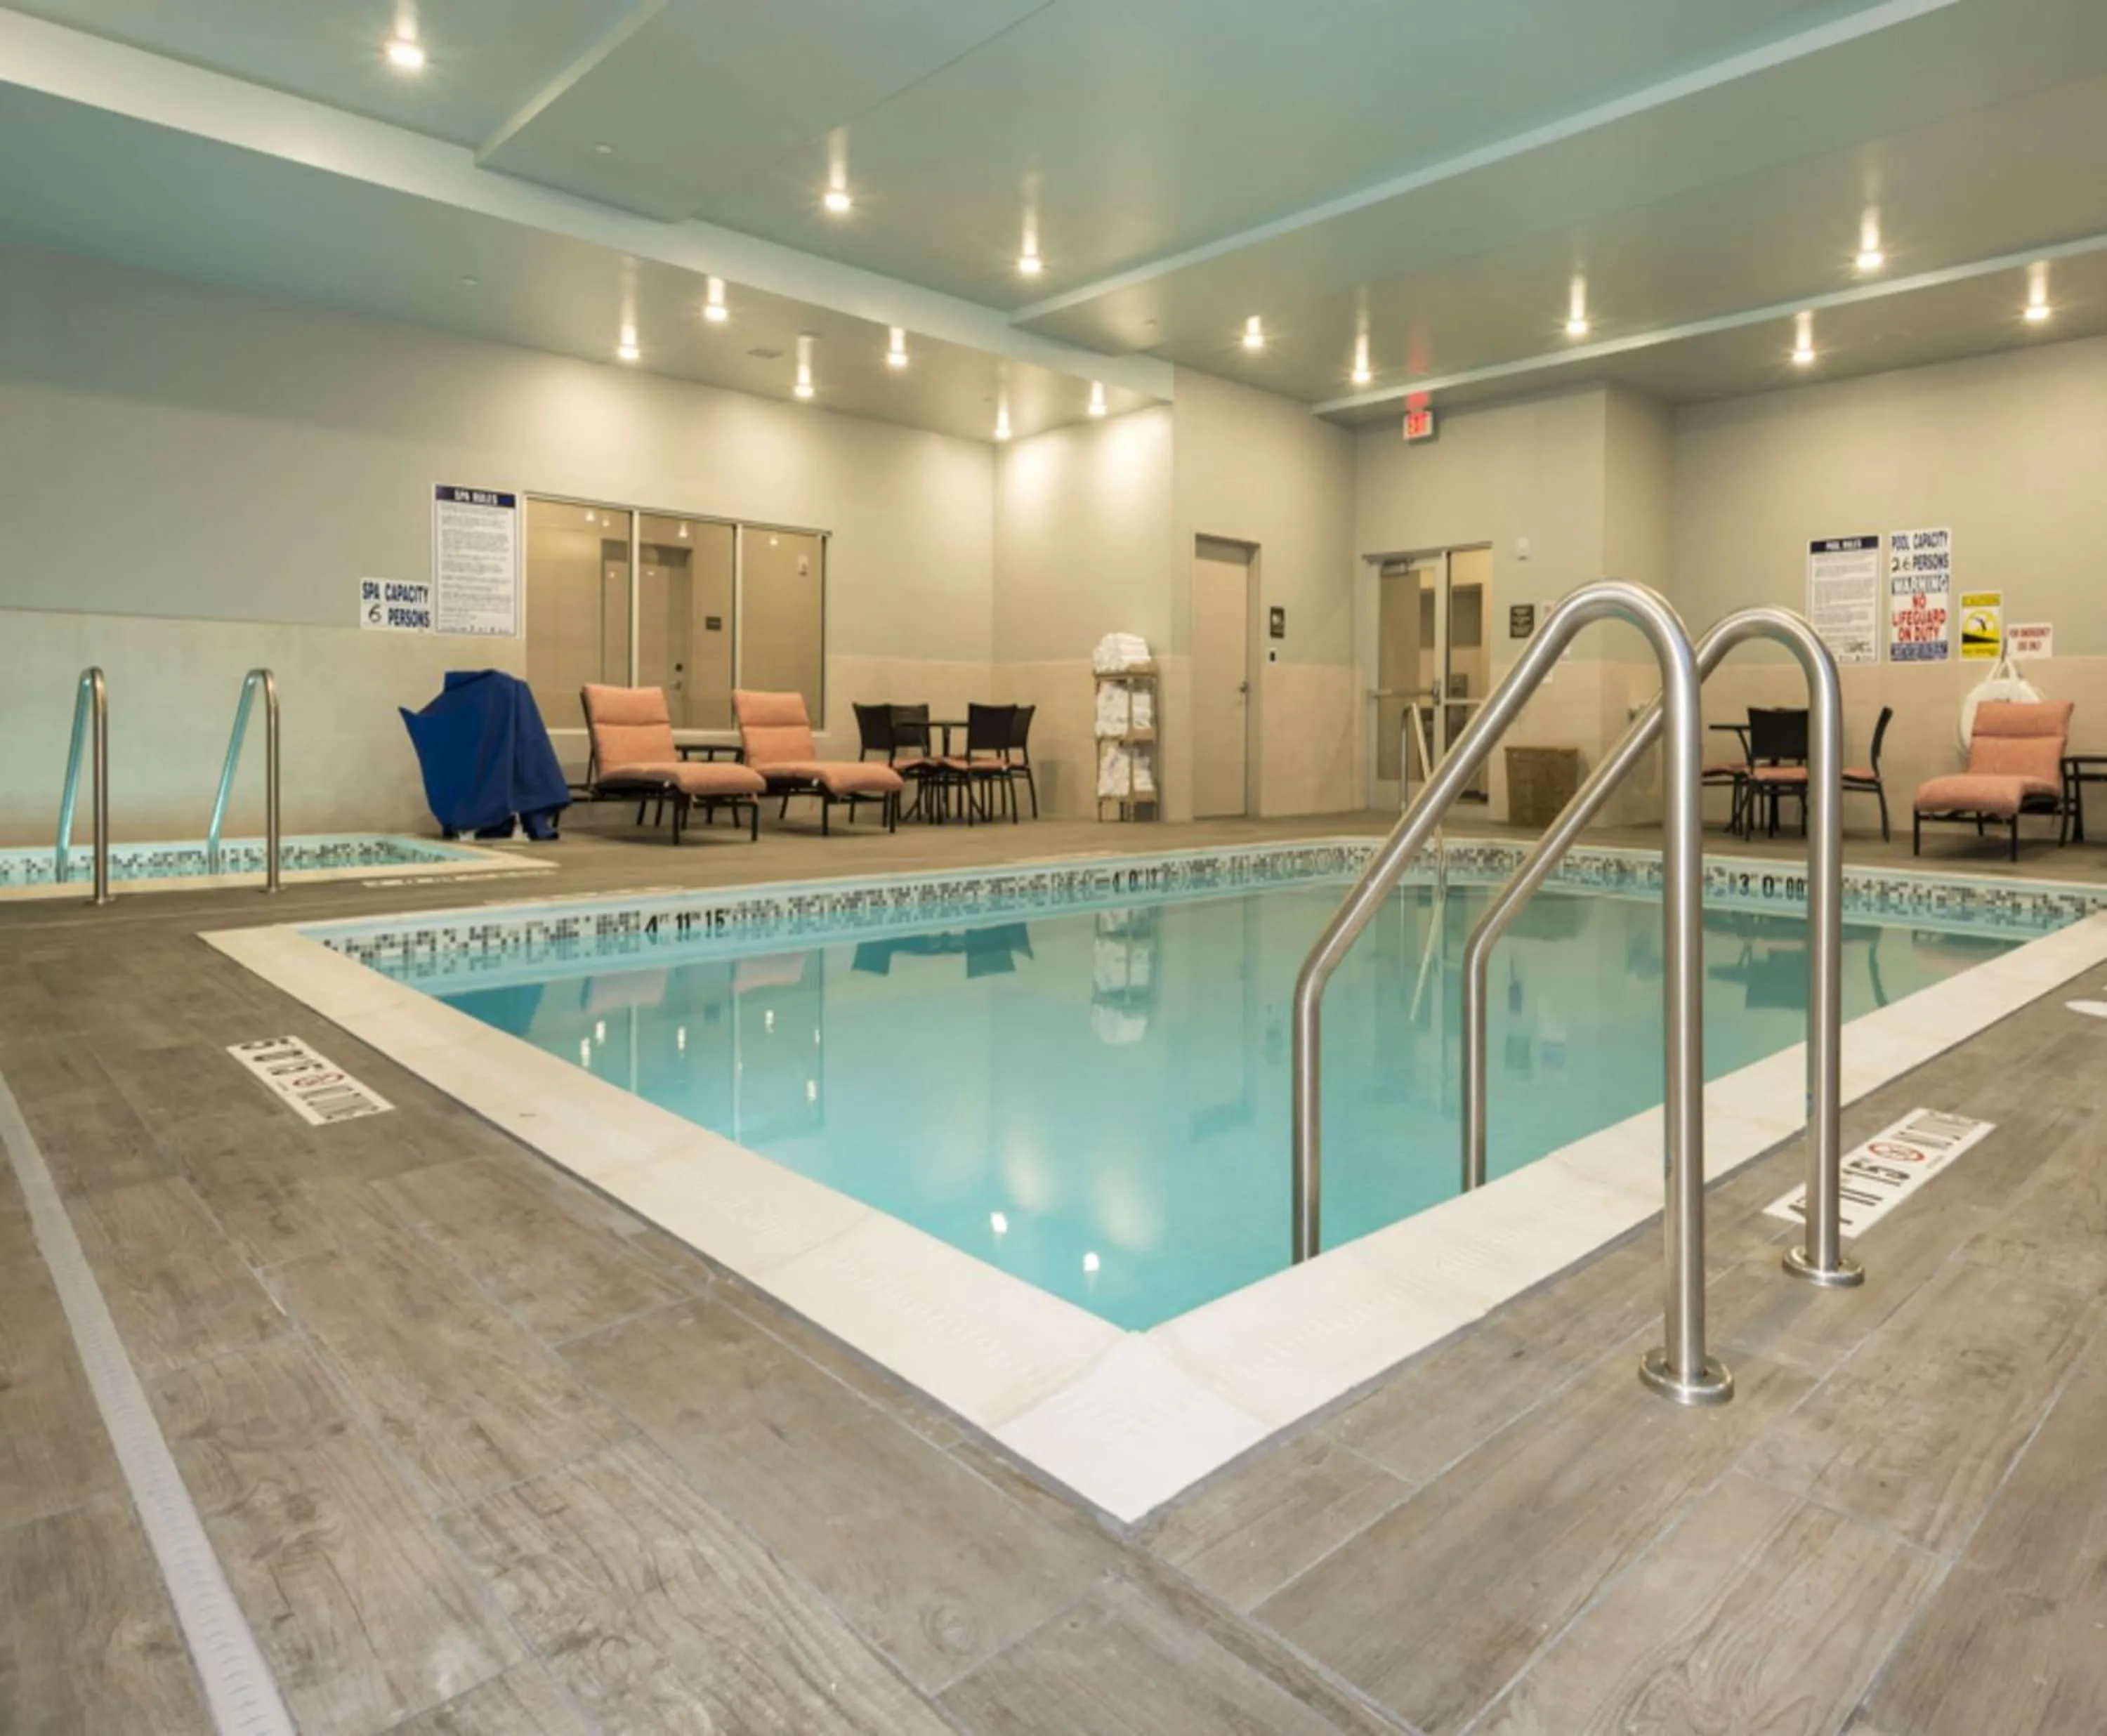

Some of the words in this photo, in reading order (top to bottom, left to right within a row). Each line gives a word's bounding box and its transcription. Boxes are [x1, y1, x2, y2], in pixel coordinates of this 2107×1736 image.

[1891, 534, 1910, 551] POOL
[1912, 530, 1948, 549] CAPACITY
[1912, 552, 1949, 571] PERSONS
[362, 581, 380, 600] SPA
[384, 582, 428, 603] CAPACITY
[1912, 593, 1926, 609] NO
[368, 603, 382, 624] 6
[388, 607, 431, 629] PERSONS
[1891, 607, 1947, 627] LIFEGUARD
[1898, 627, 1911, 643] ON
[1914, 626, 1939, 641] DUTY
